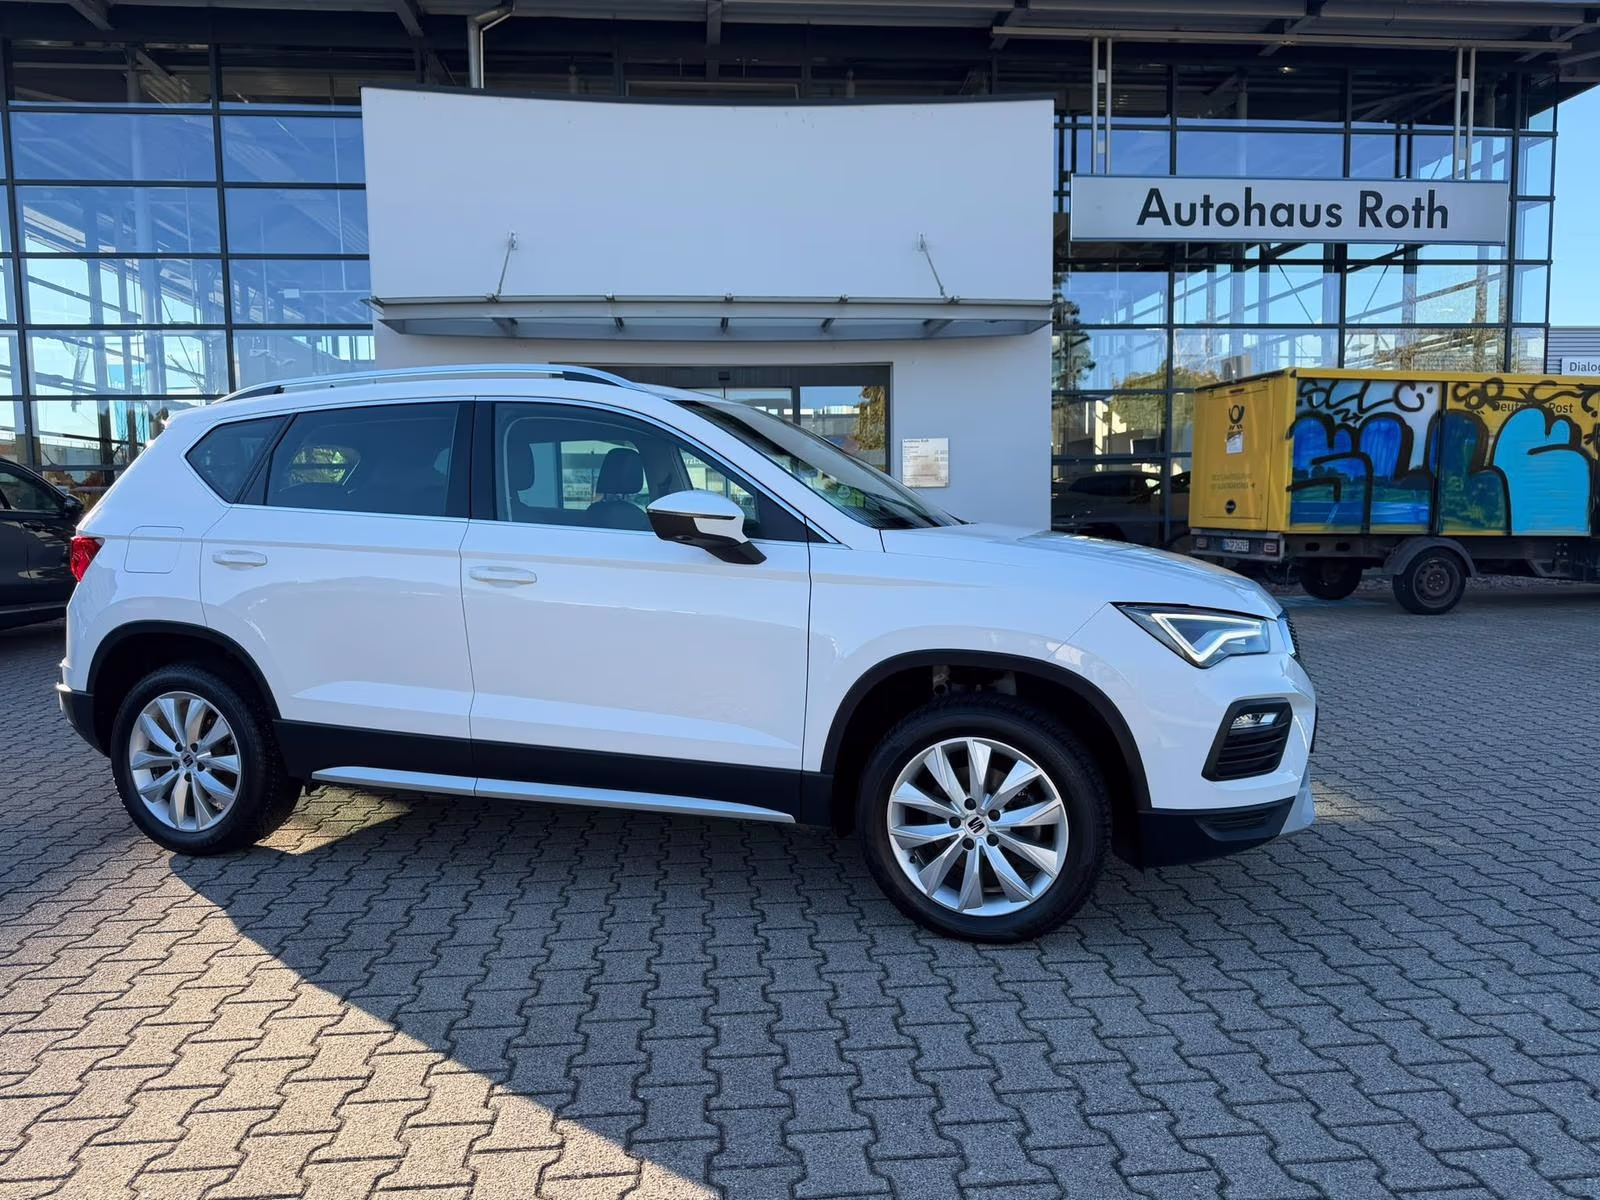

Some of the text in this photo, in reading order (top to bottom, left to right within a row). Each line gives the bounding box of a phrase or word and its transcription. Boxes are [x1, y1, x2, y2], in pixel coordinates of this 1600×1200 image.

[1136, 186, 1448, 229] Autohaus Roth
[1569, 361, 1600, 374] Dialo
[1548, 402, 1574, 413] Post
